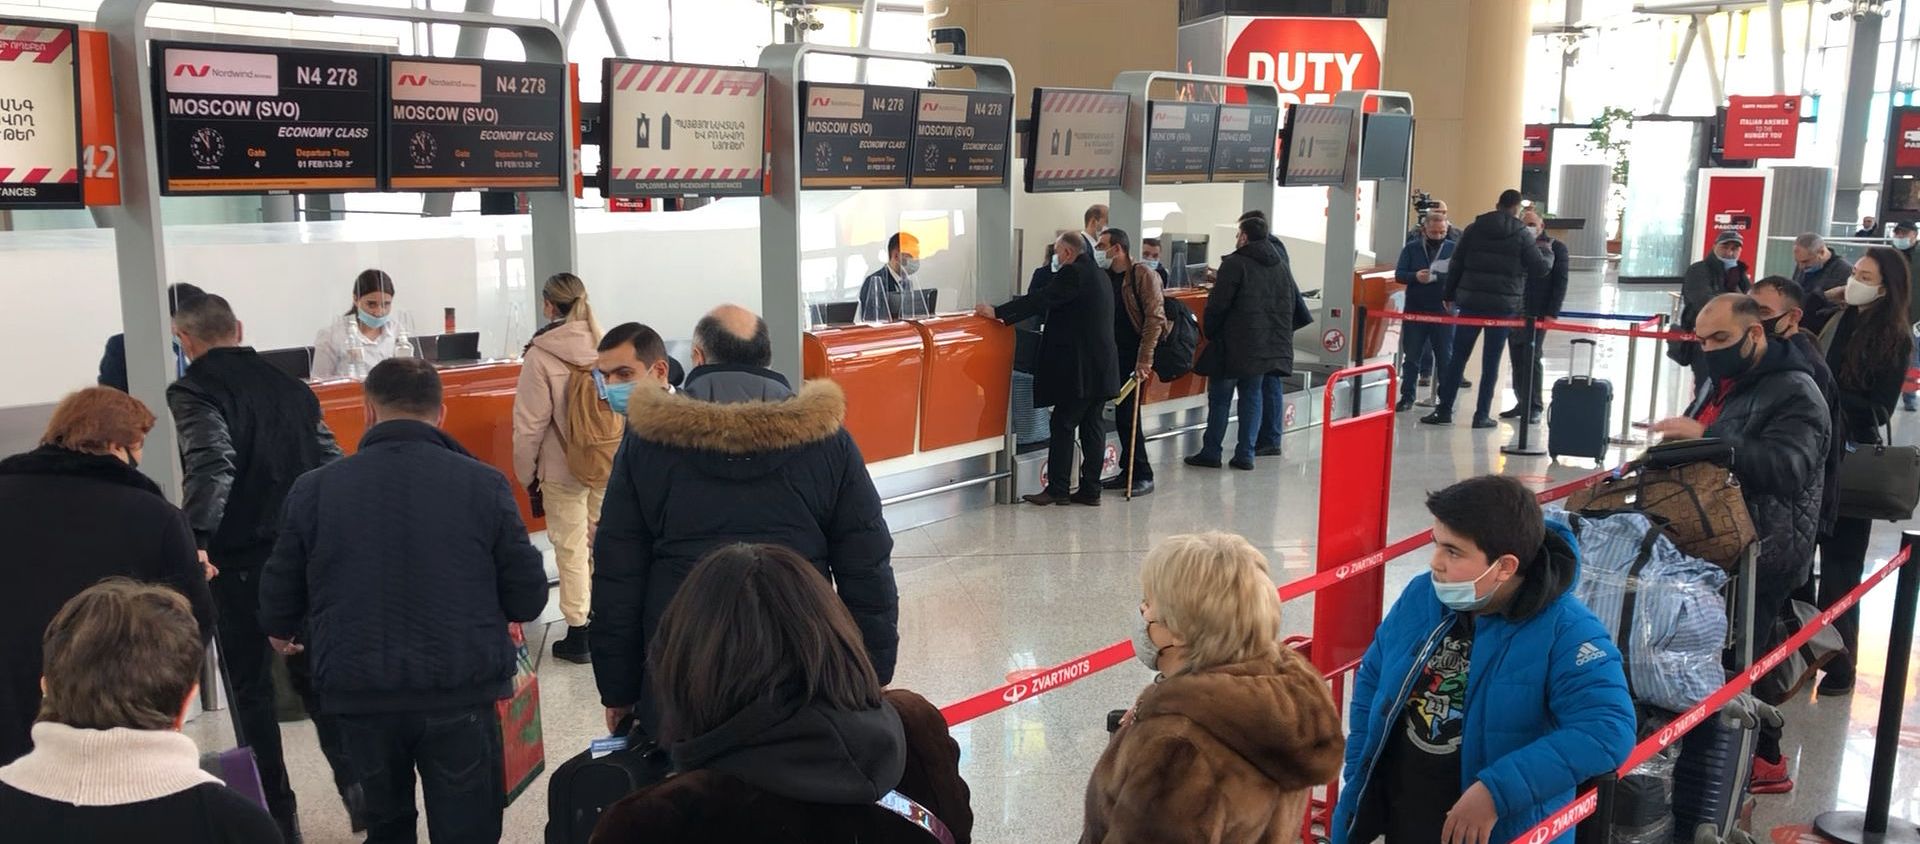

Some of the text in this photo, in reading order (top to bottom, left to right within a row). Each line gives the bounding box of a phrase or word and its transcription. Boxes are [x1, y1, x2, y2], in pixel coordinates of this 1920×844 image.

[212, 68, 253, 78] Nordwind
[297, 66, 358, 86] N4 278
[1249, 52, 1363, 91] DUTY
[496, 76, 546, 94] N4 278
[169, 98, 300, 120] MOSCOW (SVO)
[872, 97, 904, 111] N4 278
[974, 102, 1003, 116] N4 278
[393, 105, 499, 124] MOSCOW (SVO)
[0, 128, 35, 141] ԹԵՐ
[278, 126, 369, 138] ECONOMY CLASS
[480, 130, 554, 142] ECONOMY CLASS
[807, 121, 873, 137] MOSCOW (SVO)
[918, 124, 975, 140] MOSCOW (SVO)
[0, 187, 36, 197] ANCES
[1351, 552, 1384, 574] ZVARTNOTS
[1031, 659, 1091, 693] ZVARTNOTS
